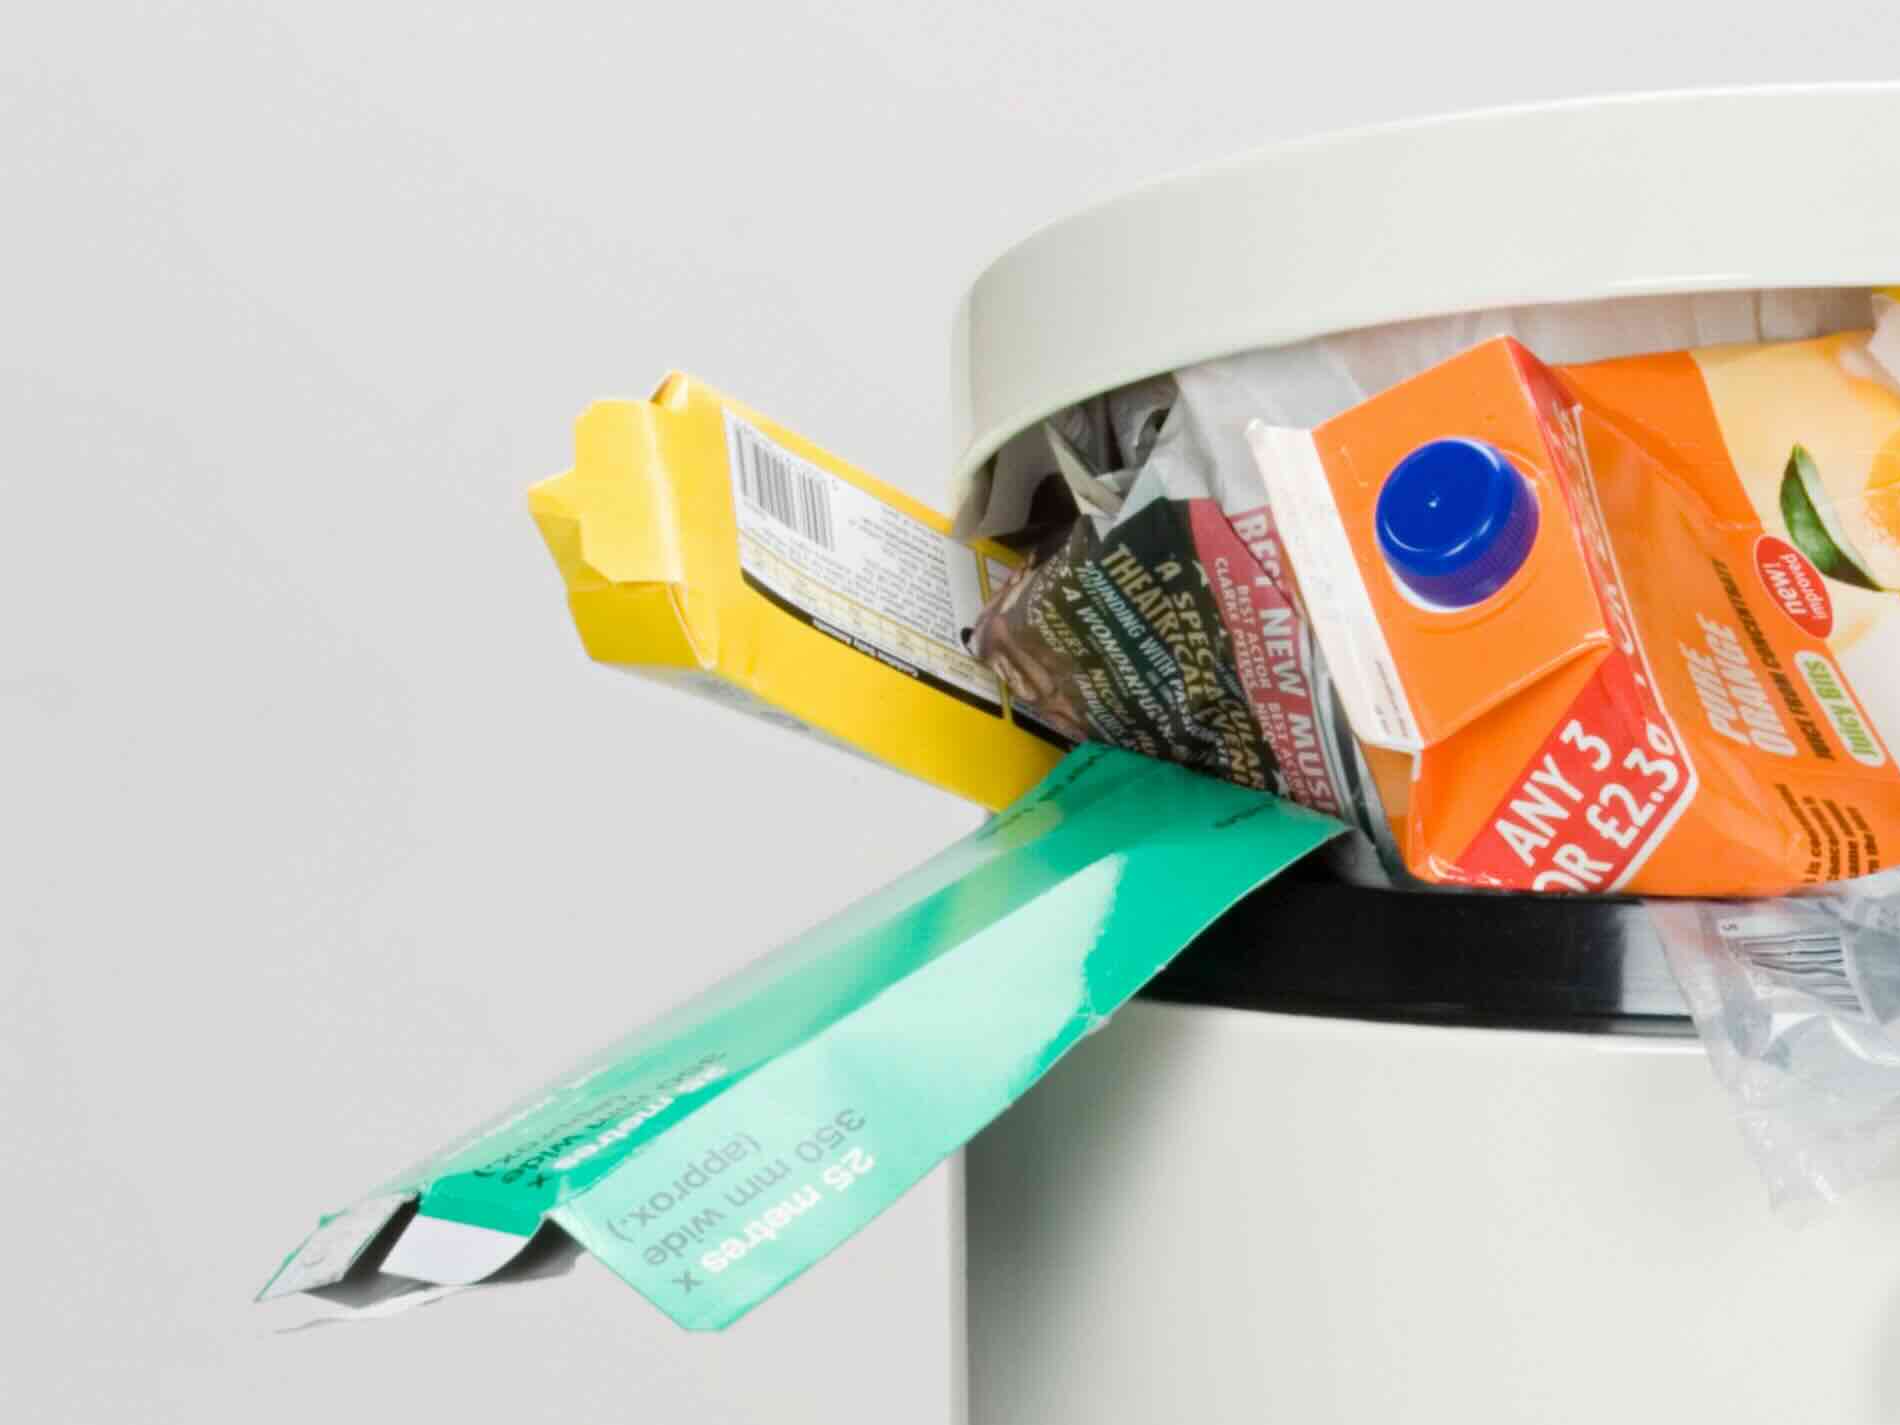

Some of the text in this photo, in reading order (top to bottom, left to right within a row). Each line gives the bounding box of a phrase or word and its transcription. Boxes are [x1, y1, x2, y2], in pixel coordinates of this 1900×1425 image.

[1101, 543, 1200, 700] THEATRICAL
[1764, 561, 1808, 617] new!
[1779, 552, 1829, 621] improved
[1138, 636, 1178, 678] WITH
[1246, 631, 1273, 689] ACTOR
[1259, 607, 1306, 696] NEW
[1495, 719, 1612, 867] ANY 3
[606, 1132, 763, 1245] (approx.)
[642, 1108, 866, 1267] 350 mm wide
[671, 1146, 876, 1295] 25 metres x
